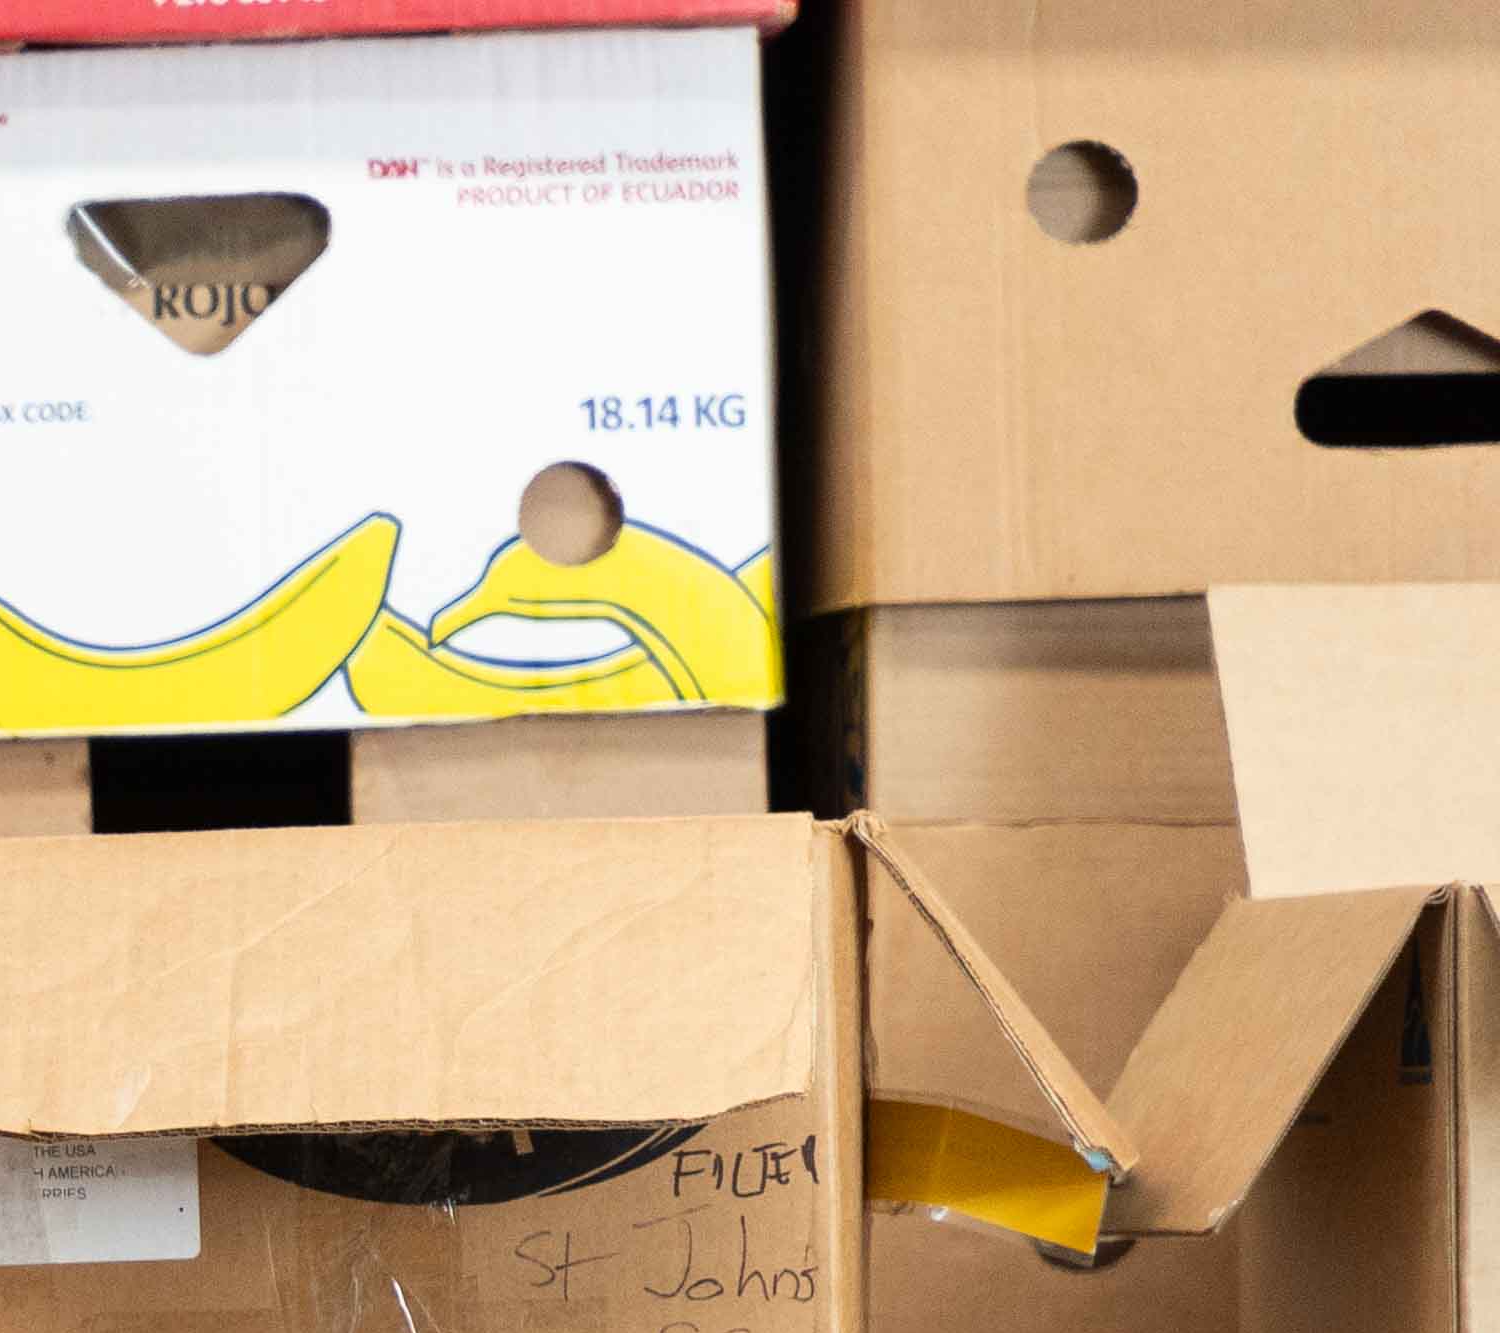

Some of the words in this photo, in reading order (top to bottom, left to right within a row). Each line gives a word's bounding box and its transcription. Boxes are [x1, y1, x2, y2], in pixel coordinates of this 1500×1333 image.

[437, 157, 453, 177] is
[462, 161, 476, 177] a
[484, 155, 605, 180] Registered
[616, 150, 739, 173] Trademark
[458, 183, 571, 207] PRODUCT
[582, 183, 612, 204] OF
[622, 180, 739, 203] ECUADOR
[151, 281, 276, 326] ROJO
[23, 402, 88, 424] CODE
[579, 397, 680, 431] 18.14
[694, 394, 746, 427] KG
[33, 1145, 61, 1158] THE
[65, 1144, 96, 1157] USA
[49, 1165, 114, 1179] AMERICA
